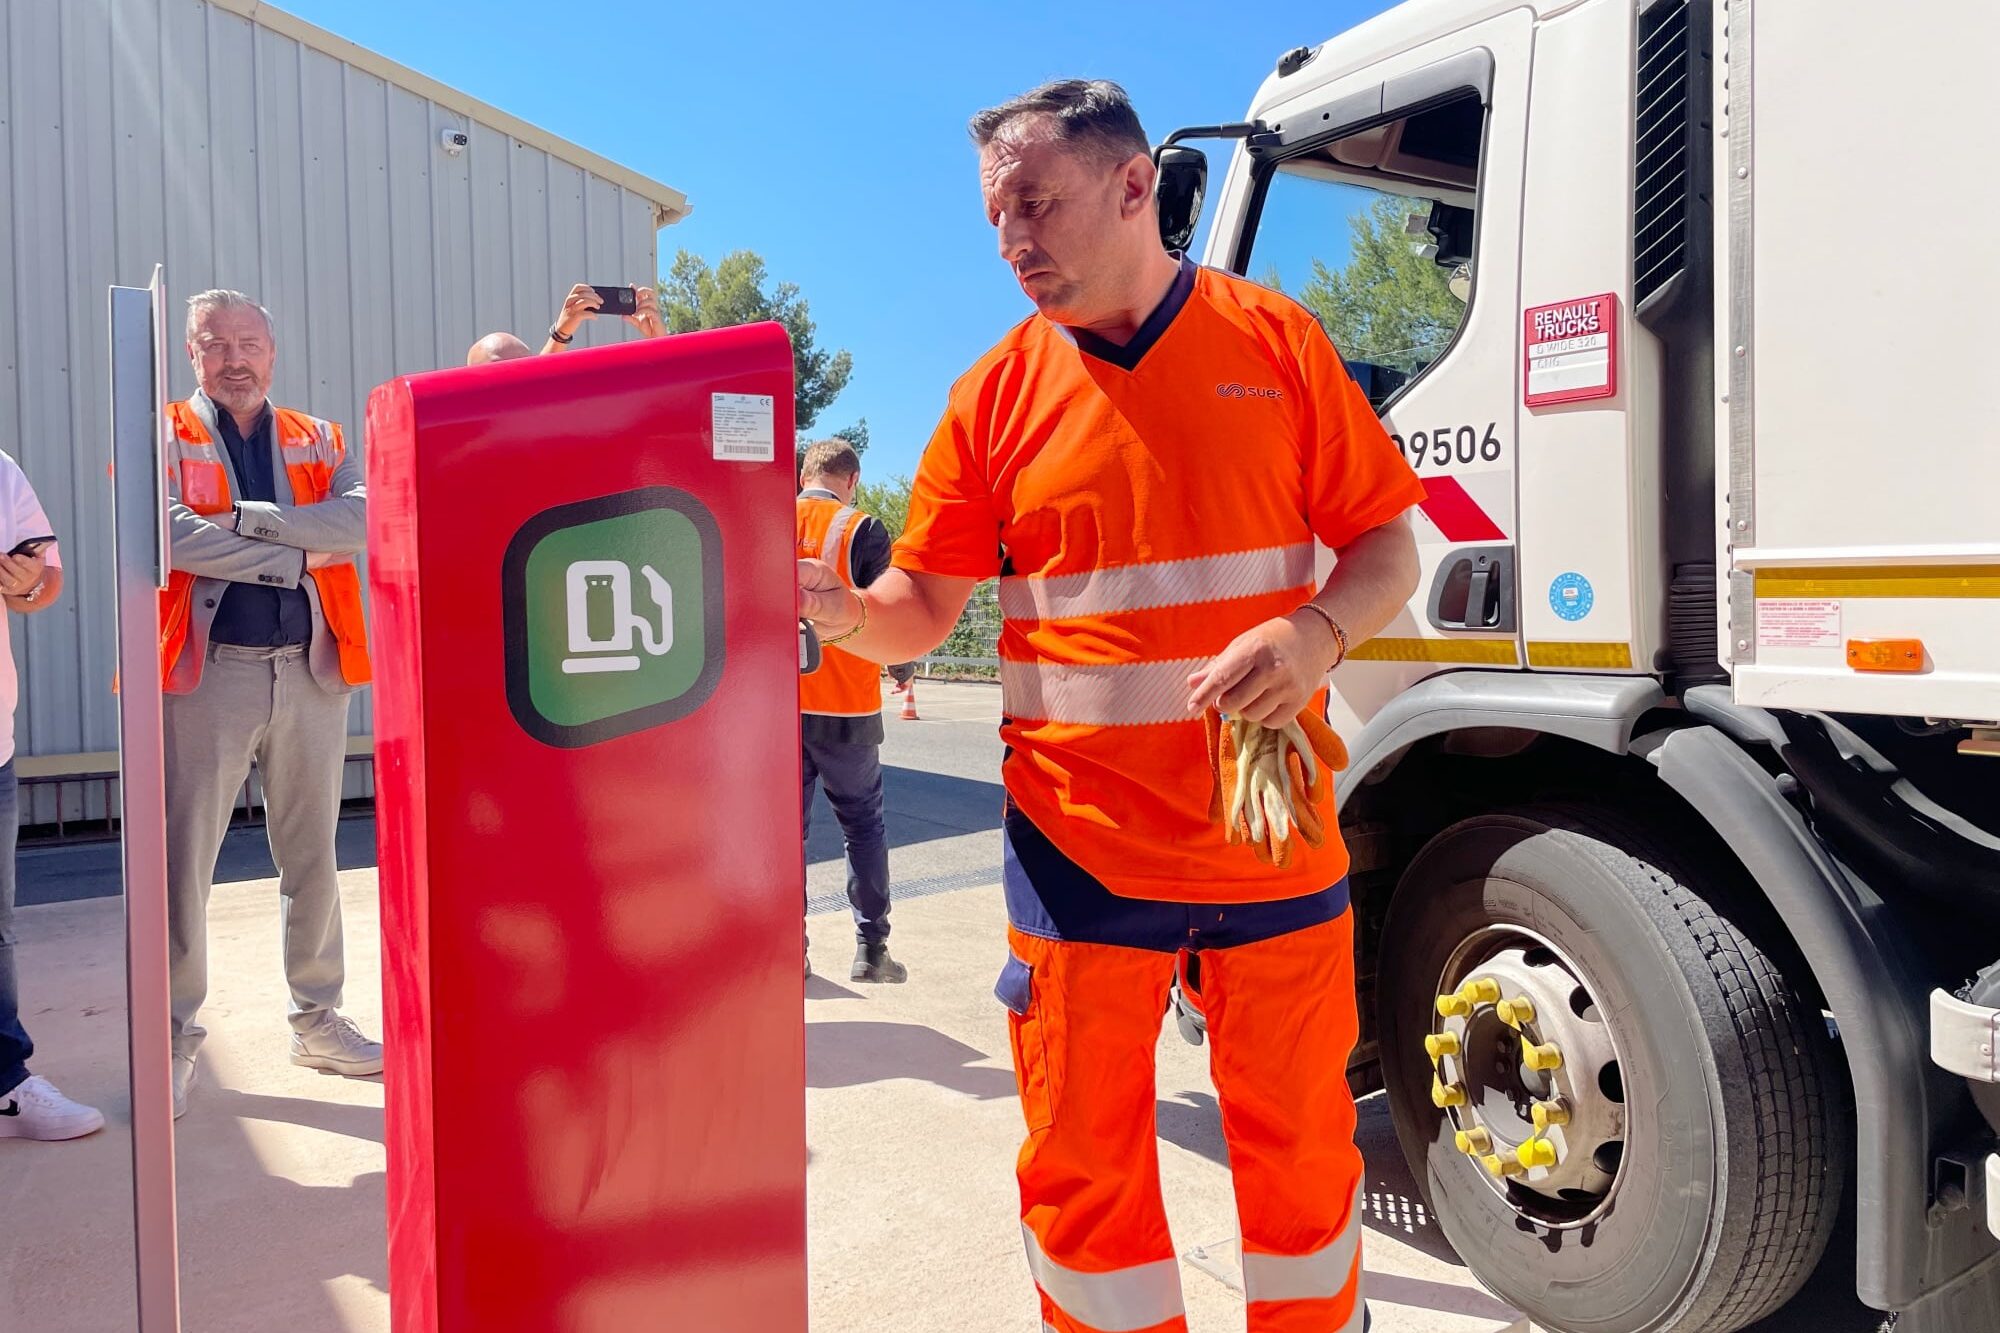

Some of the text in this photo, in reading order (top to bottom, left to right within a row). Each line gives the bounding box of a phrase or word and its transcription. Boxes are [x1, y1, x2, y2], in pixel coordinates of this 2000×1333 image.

[1535, 302, 1599, 326] RENAULT
[1535, 316, 1599, 339] TRUCKS
[1547, 340, 1575, 352] WIDE
[1577, 336, 1596, 348] 320
